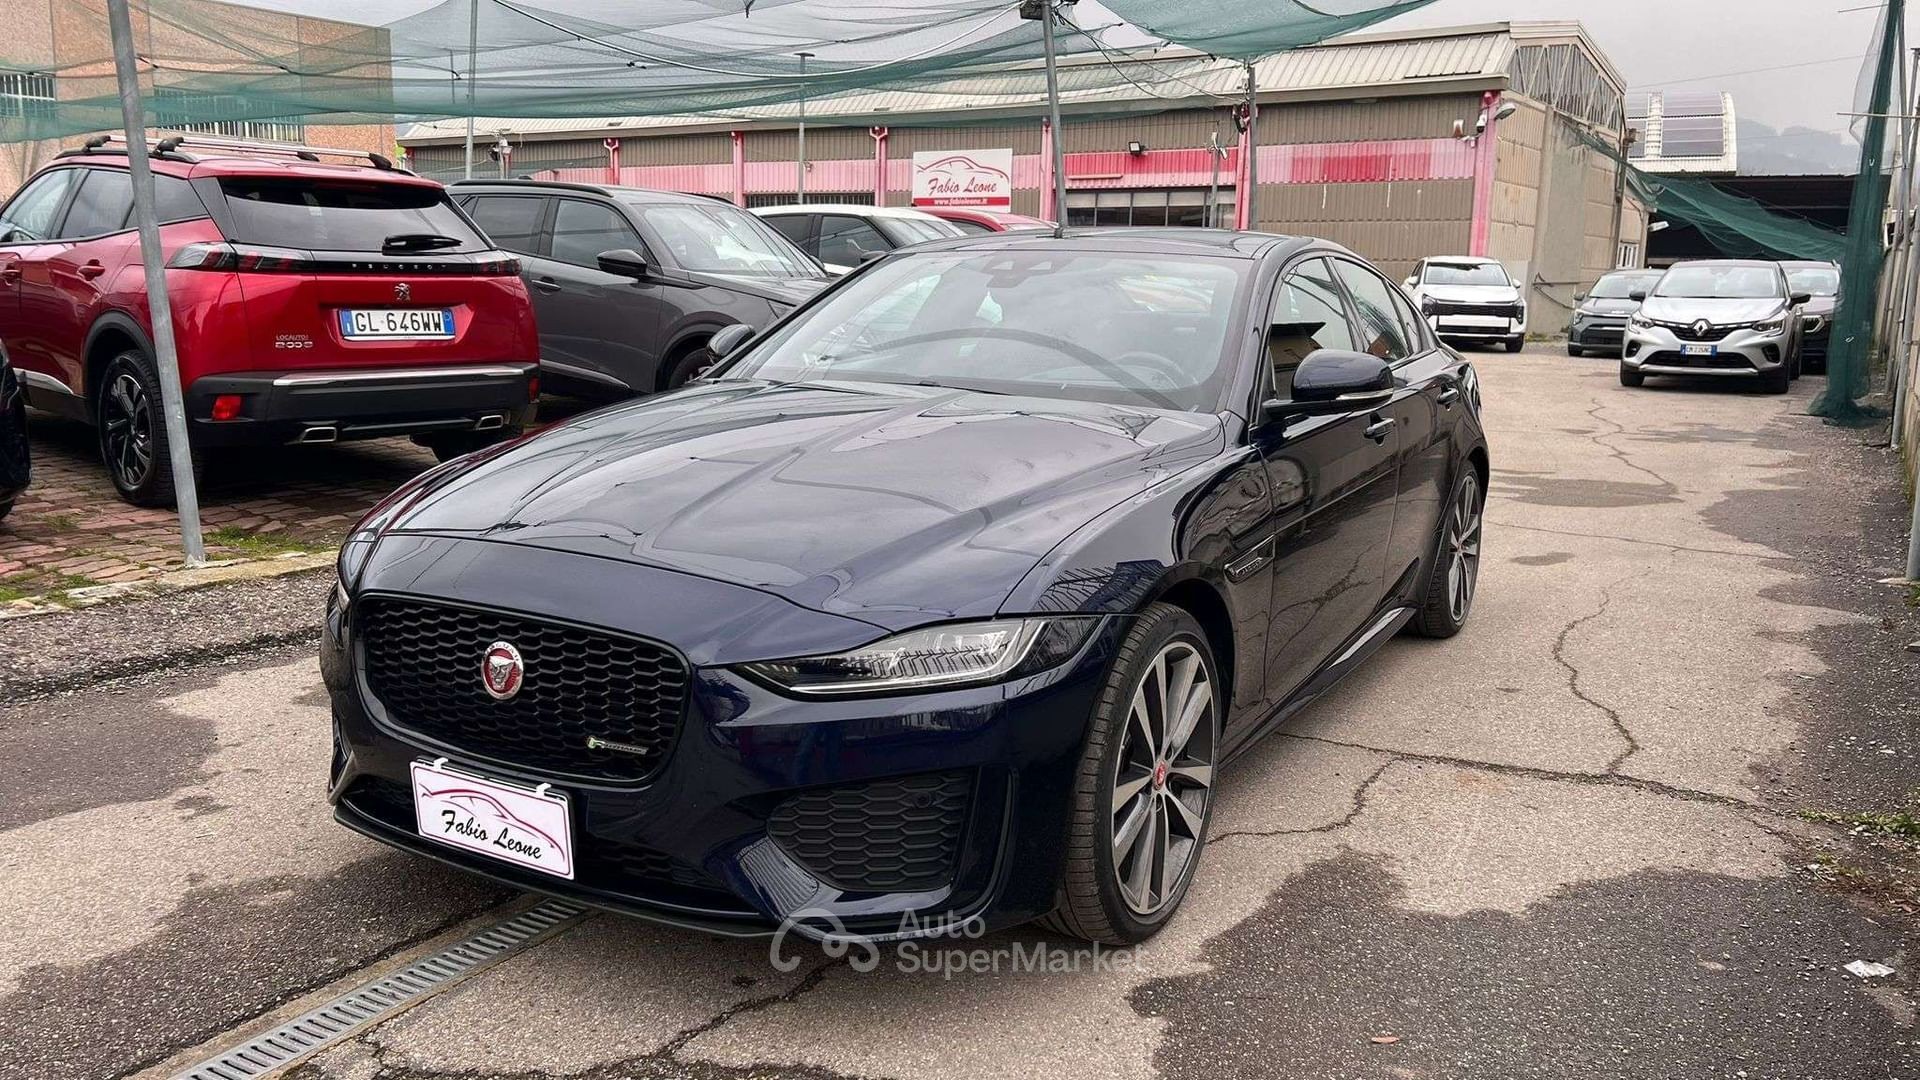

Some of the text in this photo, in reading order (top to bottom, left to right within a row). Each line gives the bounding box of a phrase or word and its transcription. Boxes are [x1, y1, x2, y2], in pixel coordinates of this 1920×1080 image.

[927, 176, 997, 197] Fabio Leone
[355, 312, 442, 332] GL 646WW
[441, 810, 541, 860] Fabio Leone
